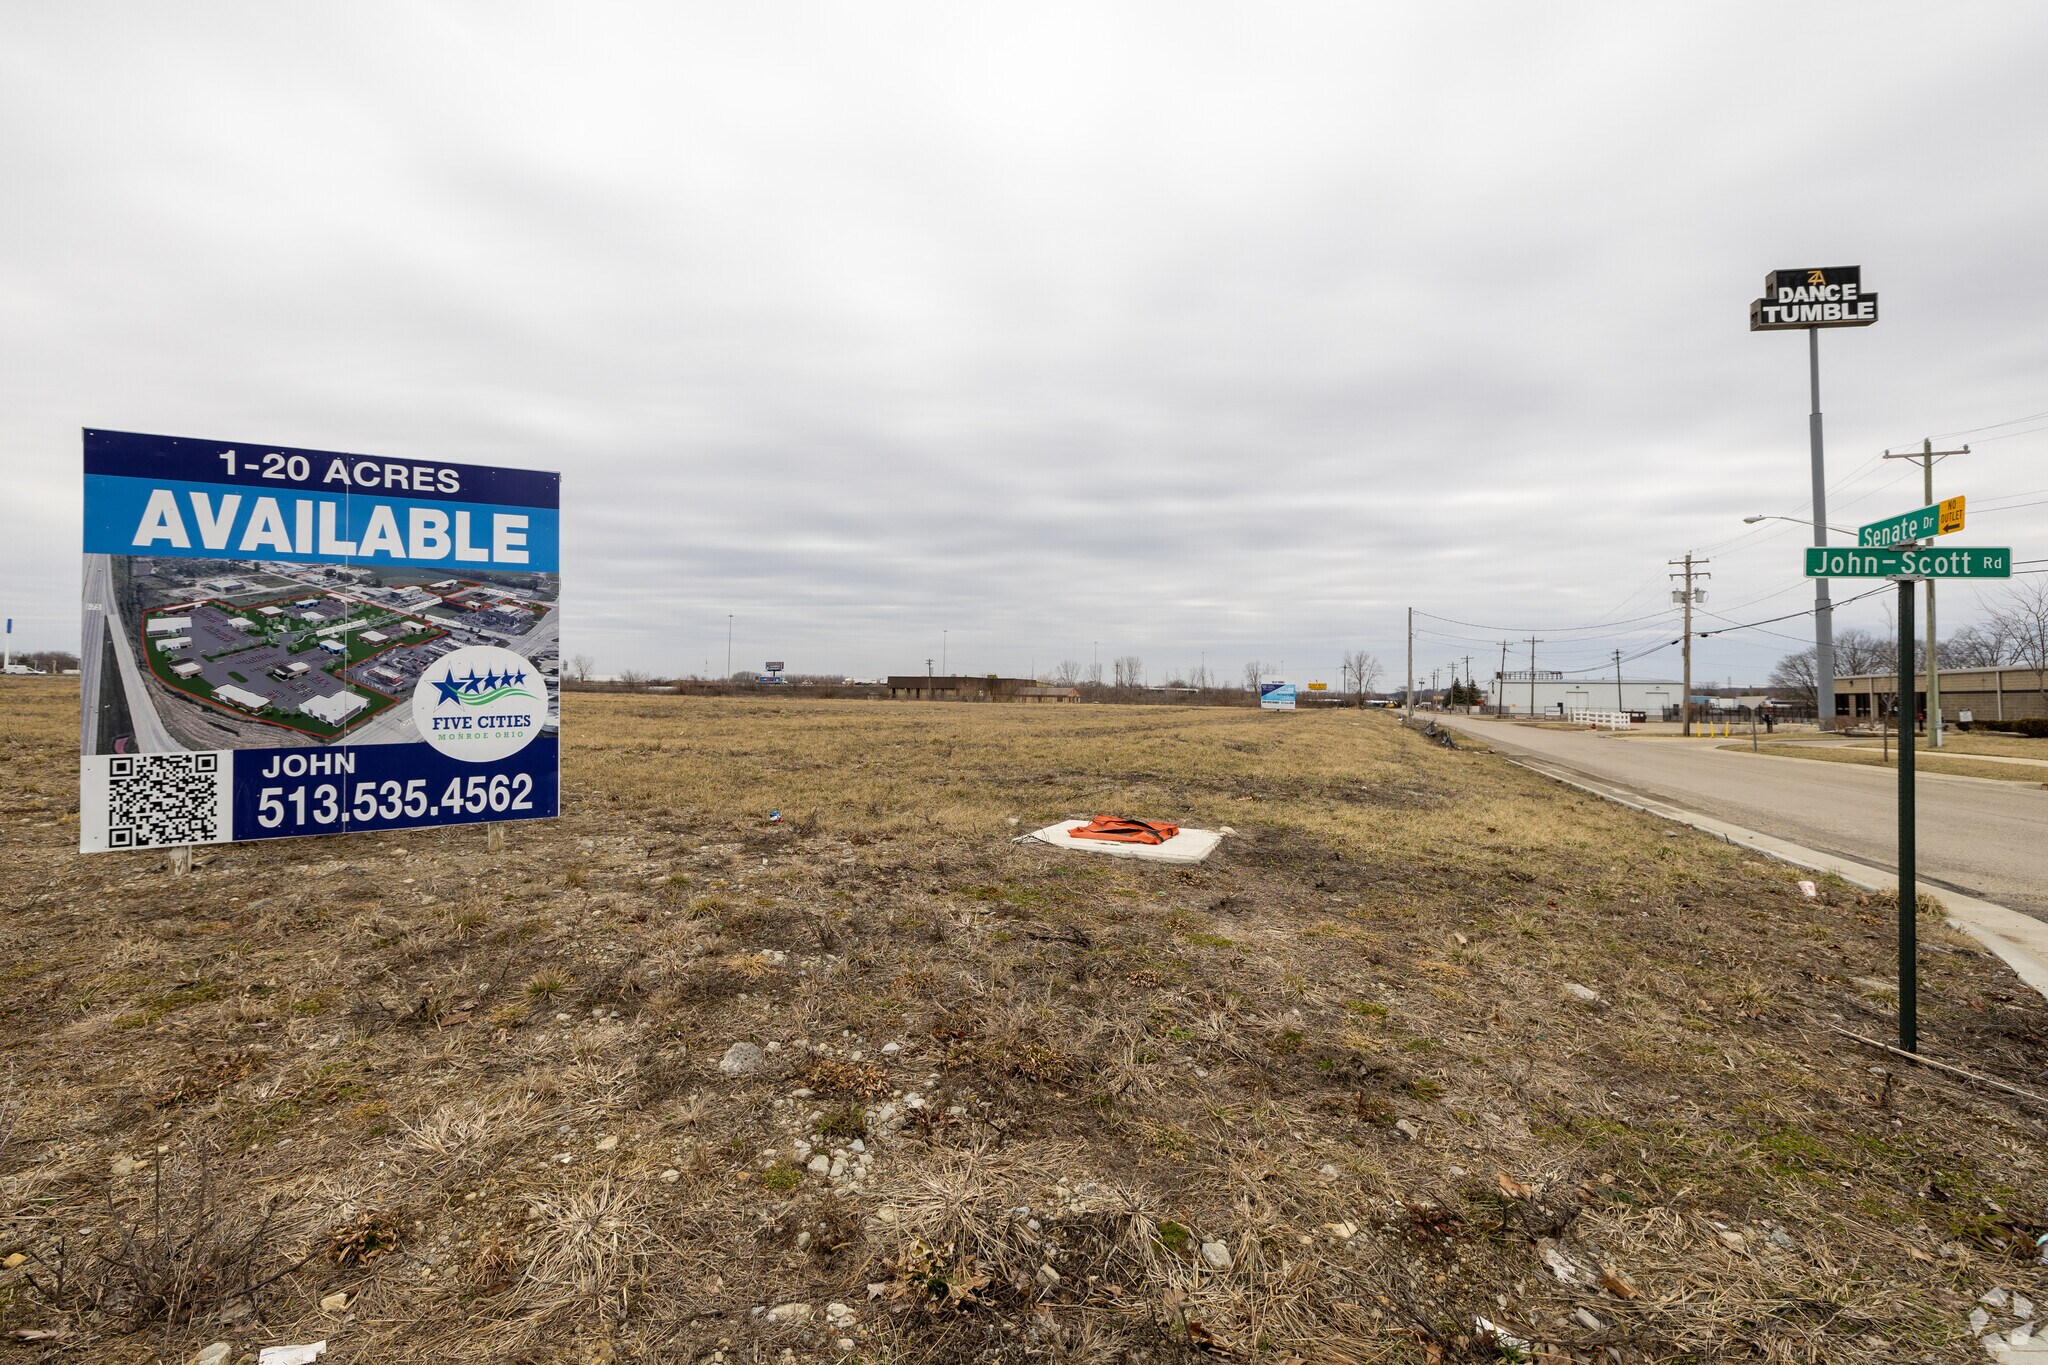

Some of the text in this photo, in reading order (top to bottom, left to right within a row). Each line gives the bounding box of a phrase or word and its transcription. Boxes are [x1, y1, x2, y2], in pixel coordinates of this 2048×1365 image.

[1778, 283, 1857, 303] DANCE
[1762, 302, 1875, 323] TUMBLE
[219, 449, 461, 494] 1-20 ACRES
[1947, 500, 1956, 510] NO
[132, 488, 530, 564] AVAILABLE
[1940, 509, 1963, 524] OUTLET
[1863, 516, 1934, 547] Senate Dr
[1814, 551, 2003, 575] John-Scott Rd
[432, 716, 472, 730] FIVE
[477, 714, 531, 729] CITIES
[438, 732, 489, 741] MONROE
[262, 752, 356, 779] JOHN
[257, 772, 533, 828] 513.535.4562
